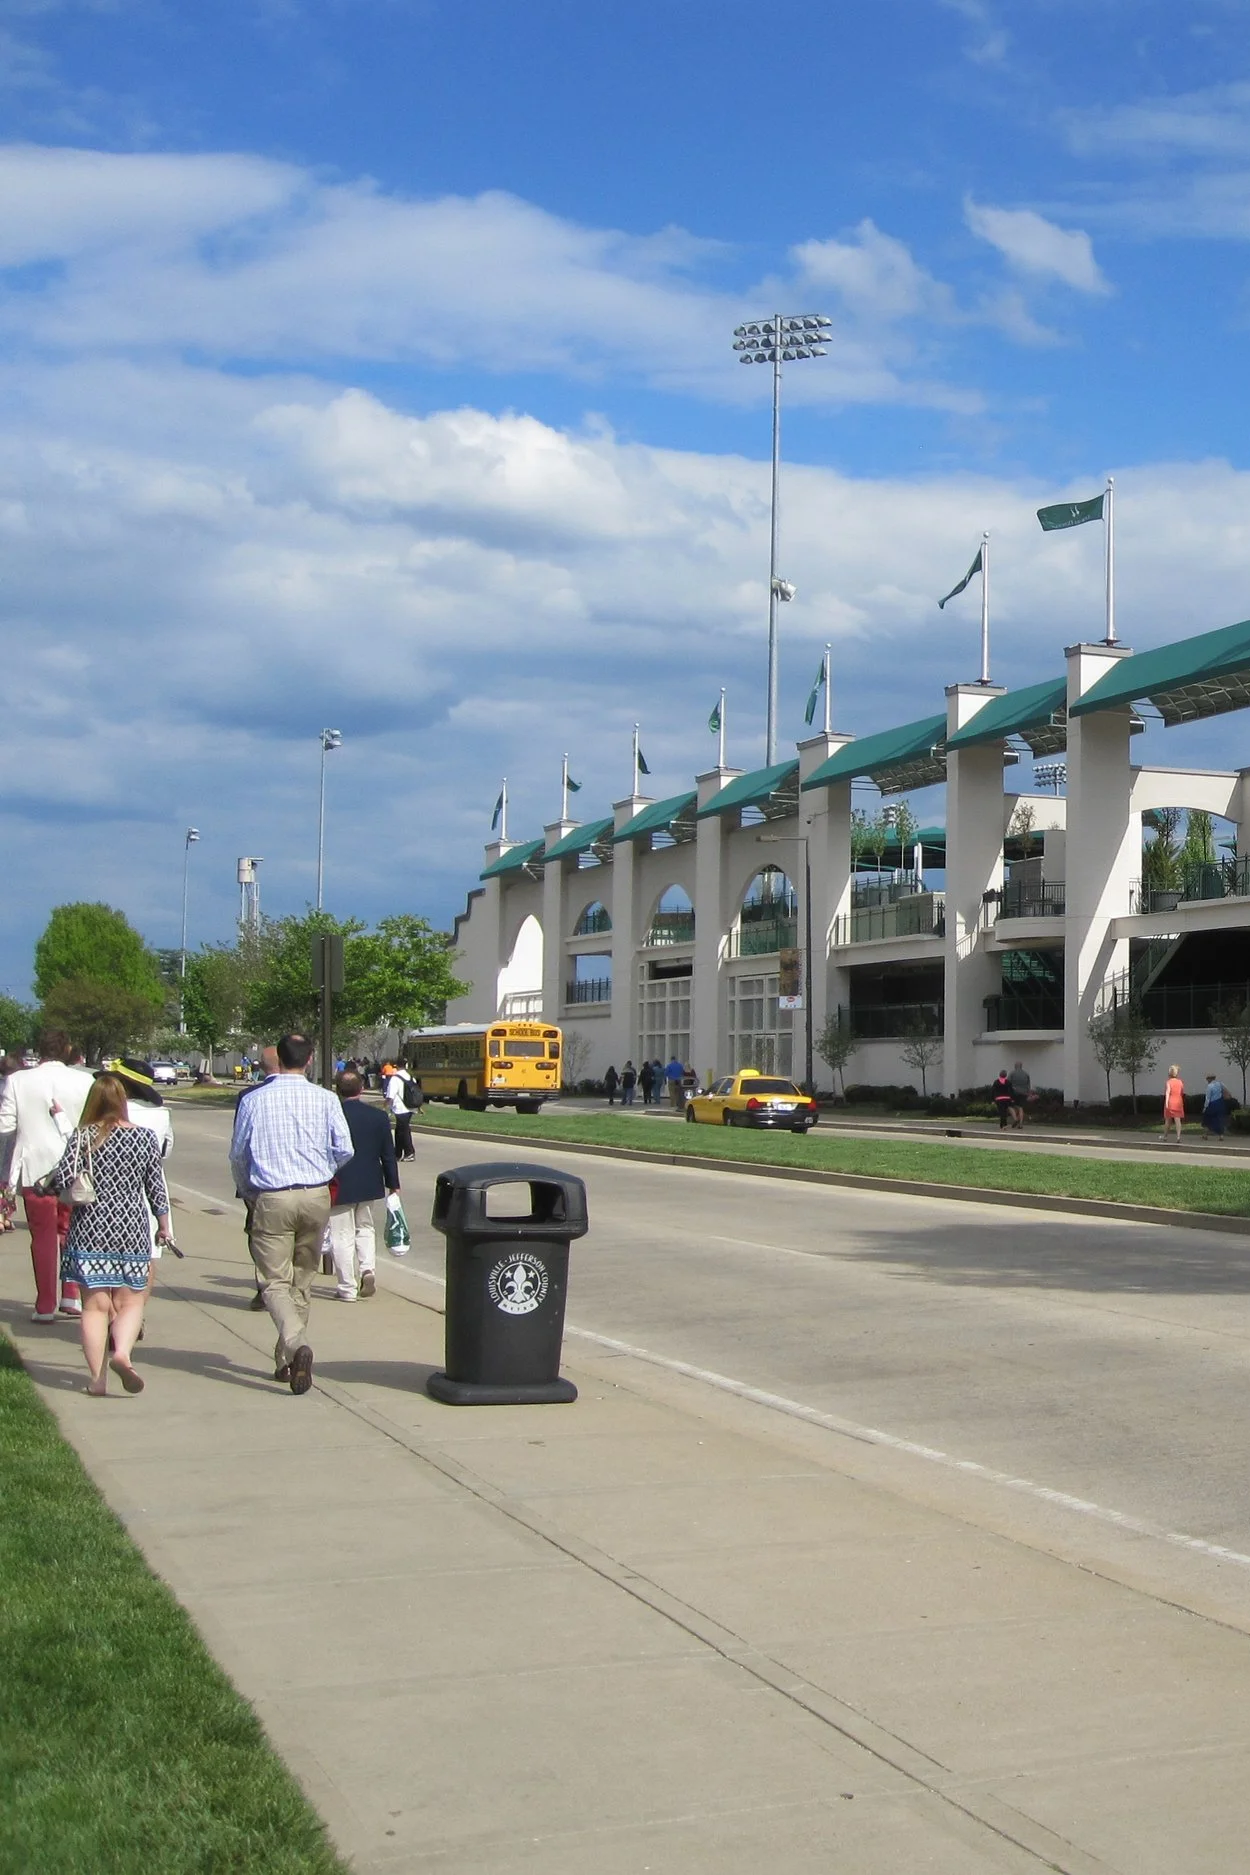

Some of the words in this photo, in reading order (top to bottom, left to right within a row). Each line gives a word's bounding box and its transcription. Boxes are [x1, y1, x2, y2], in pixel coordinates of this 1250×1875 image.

[509, 1028, 529, 1036] SCHOOL
[488, 1260, 505, 1303] LOUISVILLE
[508, 1253, 546, 1272] JEFFERSON
[537, 1272, 549, 1303] COUNTY
[503, 1303, 534, 1311] METRO
